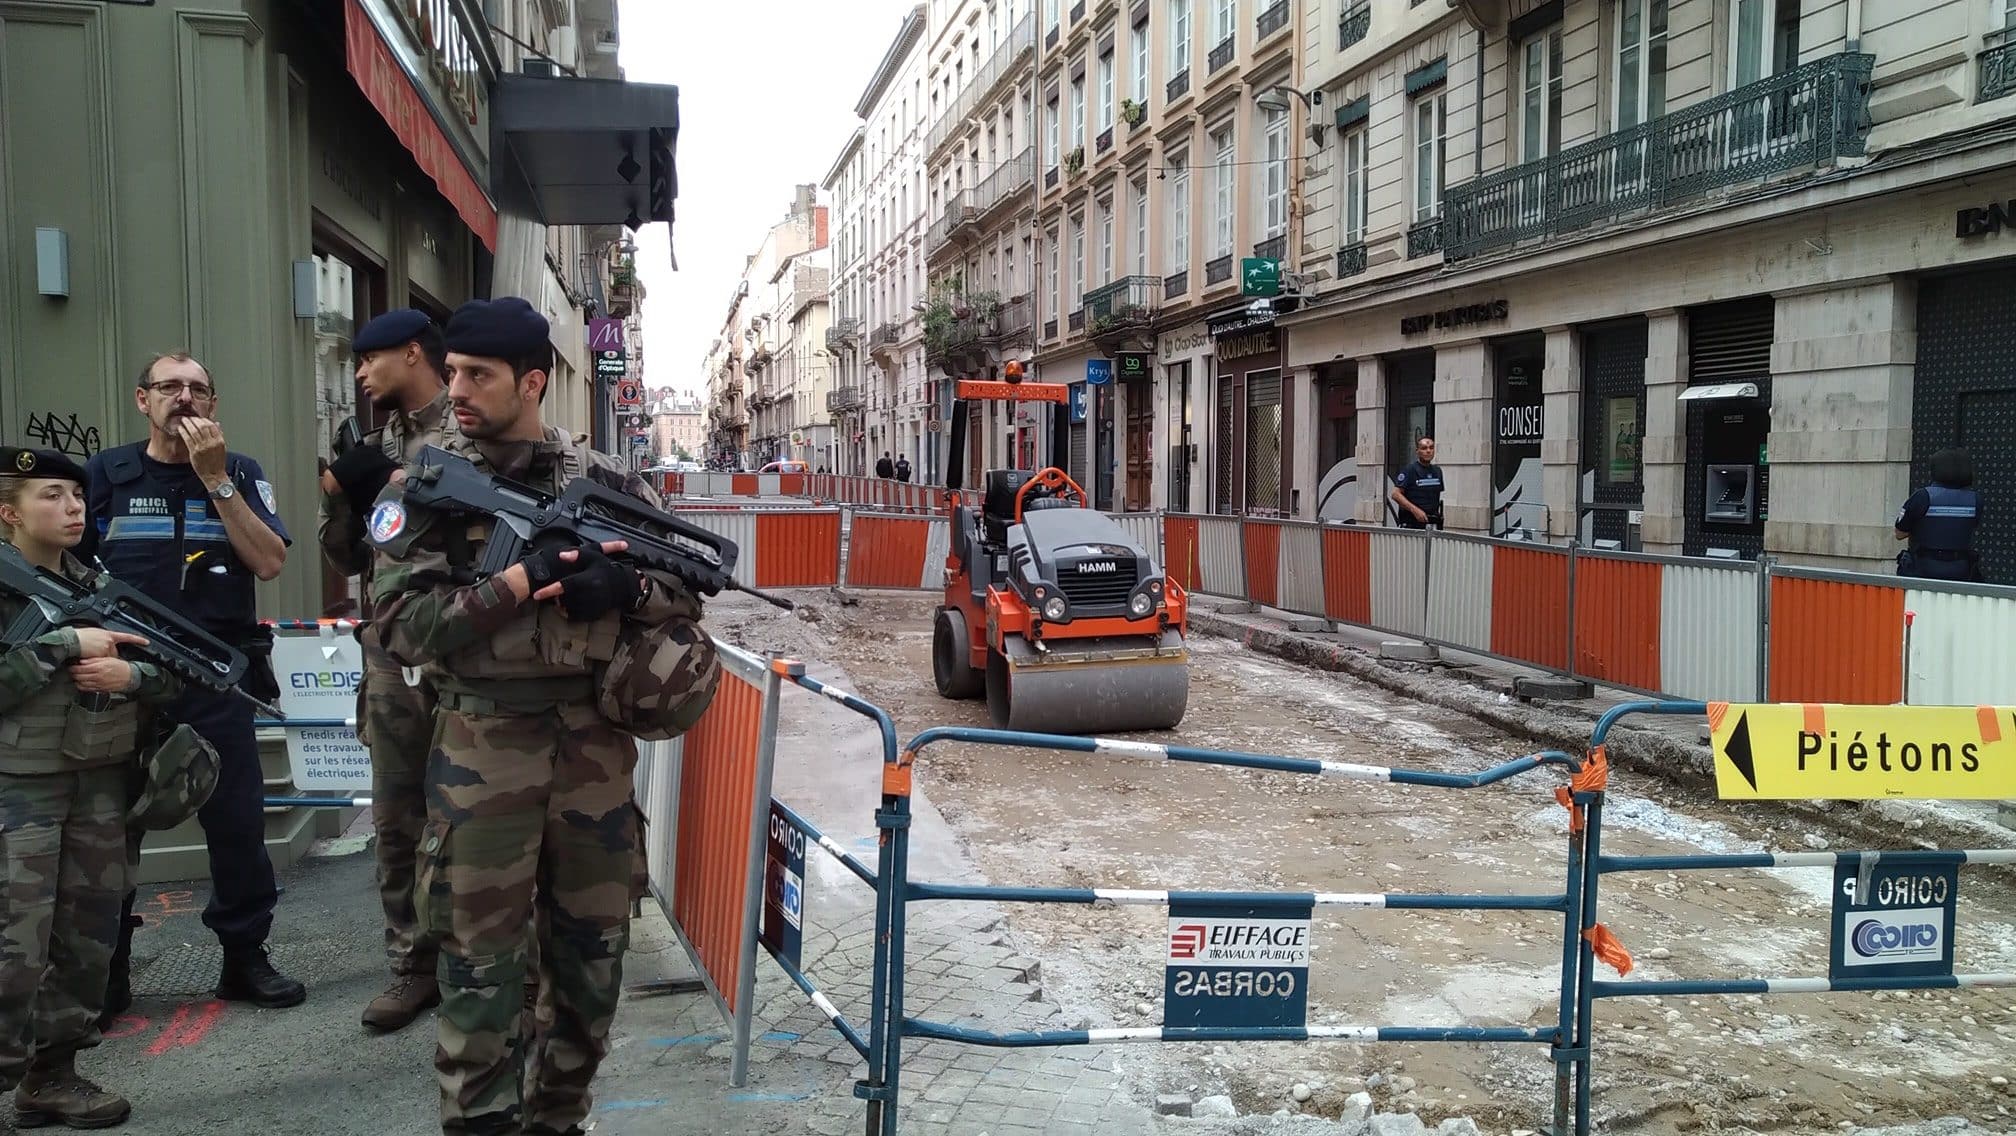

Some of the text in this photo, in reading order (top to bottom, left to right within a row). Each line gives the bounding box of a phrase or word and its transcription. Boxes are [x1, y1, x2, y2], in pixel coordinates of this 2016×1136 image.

[129, 497, 169, 507] POLICE
[1079, 561, 1116, 573] HAMM
[300, 729, 356, 740] Enedis réa
[303, 743, 364, 753] des travaux
[1797, 730, 1980, 773] Piétons
[304, 755, 371, 766] sur les résea
[306, 767, 369, 780] électriques.
[1209, 925, 1307, 946] EIFFAGE
[1208, 948, 1305, 961] TRAVAUX PUBLICS
